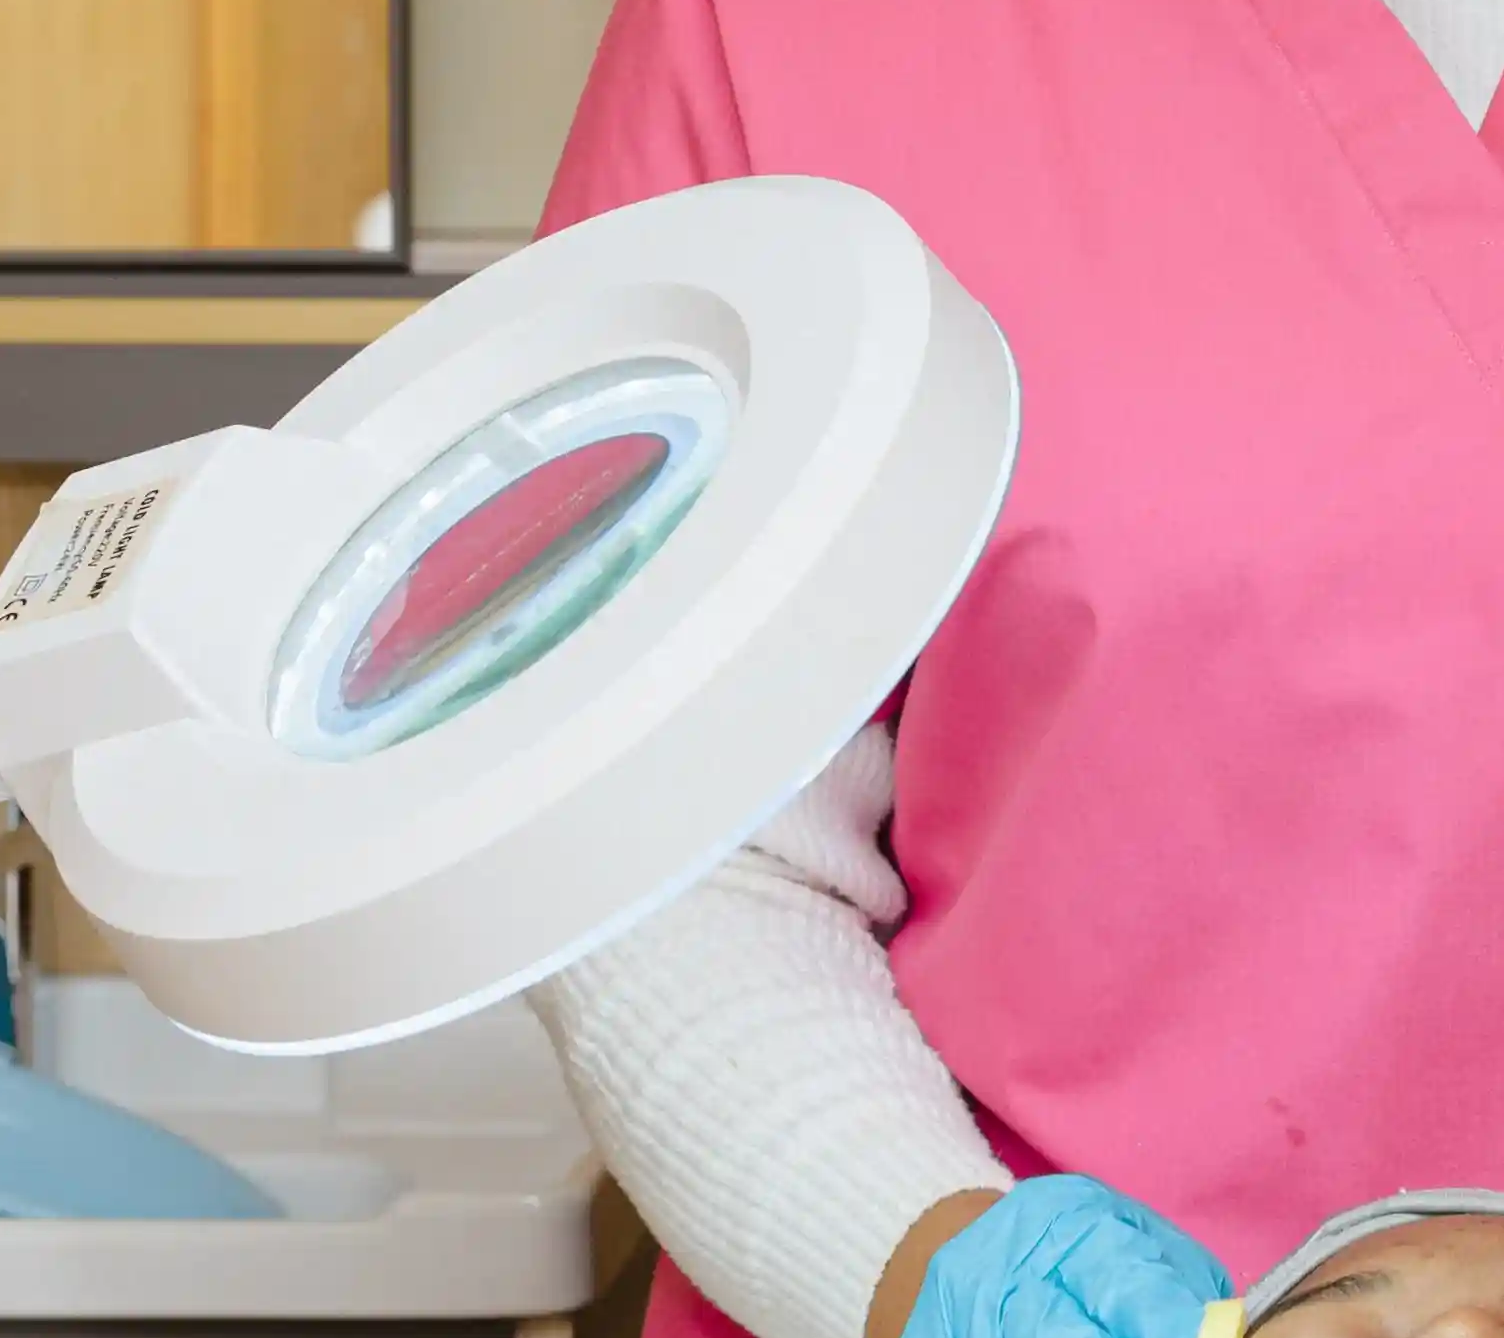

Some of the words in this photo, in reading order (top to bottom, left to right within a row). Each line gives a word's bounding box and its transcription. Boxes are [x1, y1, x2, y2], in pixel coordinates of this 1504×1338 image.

[133, 489, 159, 521] COLD
[110, 524, 139, 560] LIGHT
[87, 565, 116, 599] LAMP
